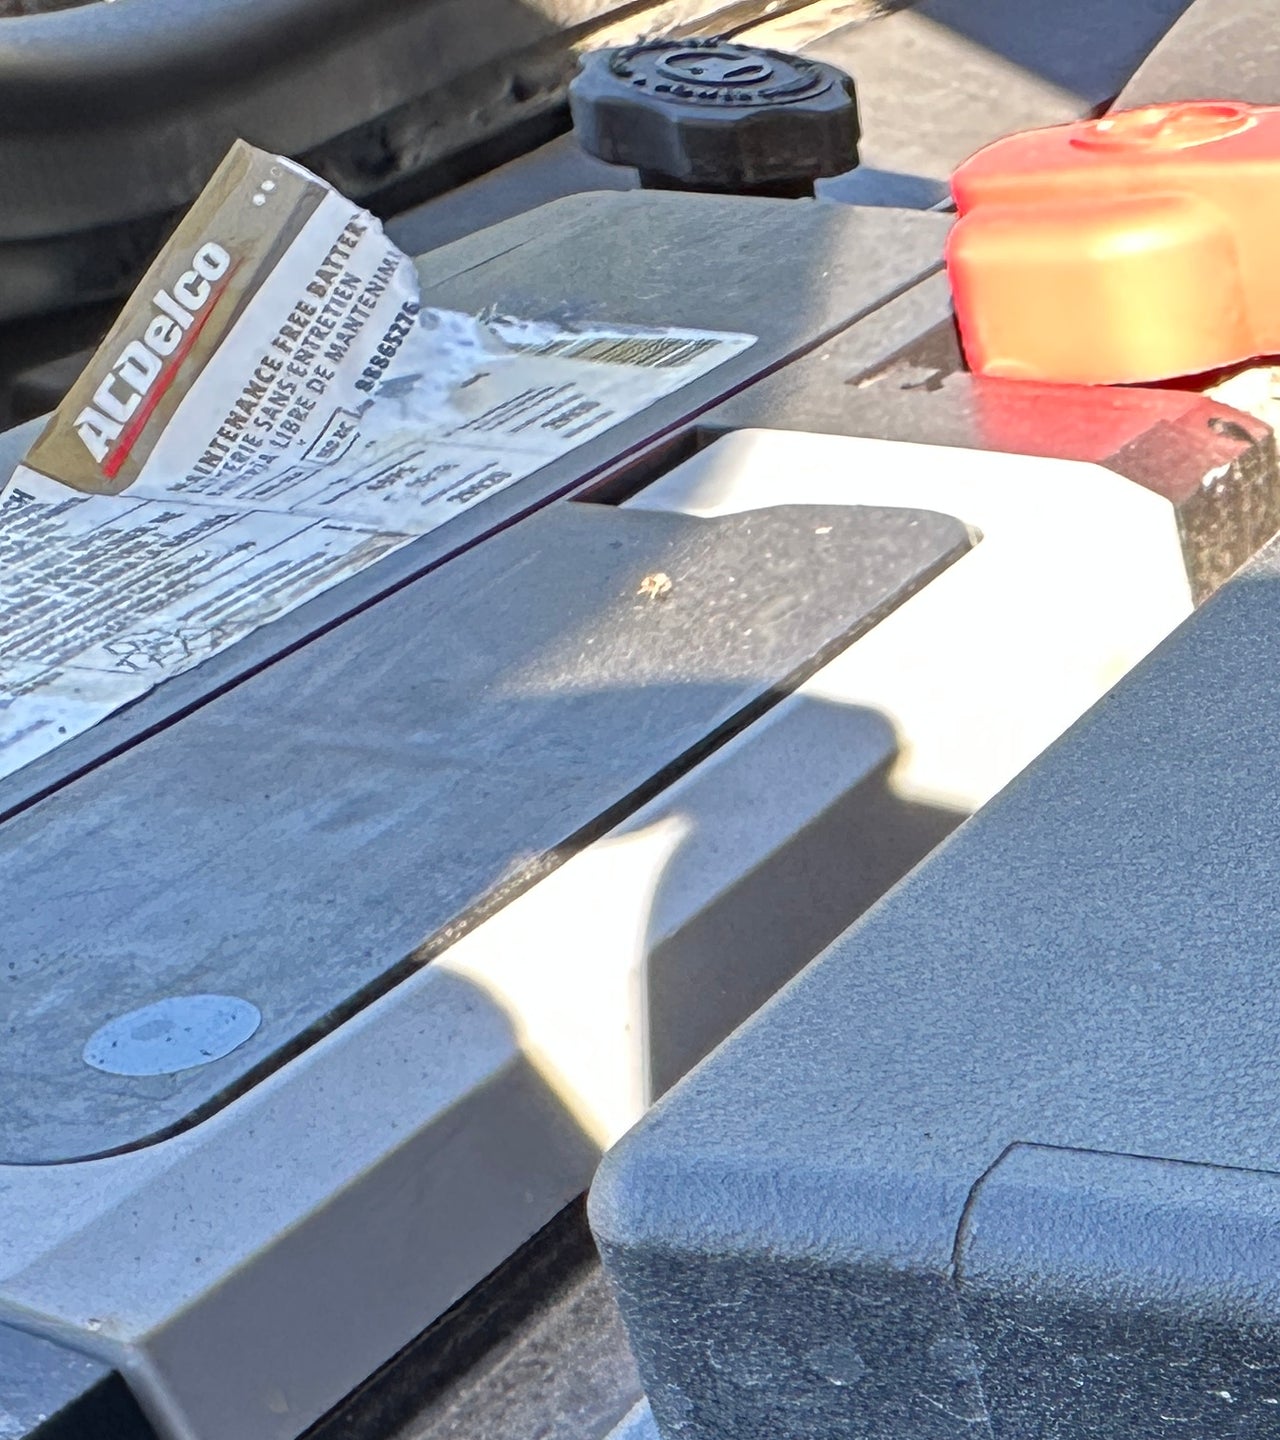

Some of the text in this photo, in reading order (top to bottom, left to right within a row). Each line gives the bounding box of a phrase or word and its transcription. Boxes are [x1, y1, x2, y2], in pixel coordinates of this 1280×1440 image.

[72, 241, 231, 464] ACDelco
[252, 377, 297, 433] SANS
[286, 270, 362, 378] ENTRETIEN
[270, 299, 317, 355] FREE
[305, 212, 367, 299] BATTER
[268, 397, 317, 451] LIBRE
[305, 364, 335, 395] DE
